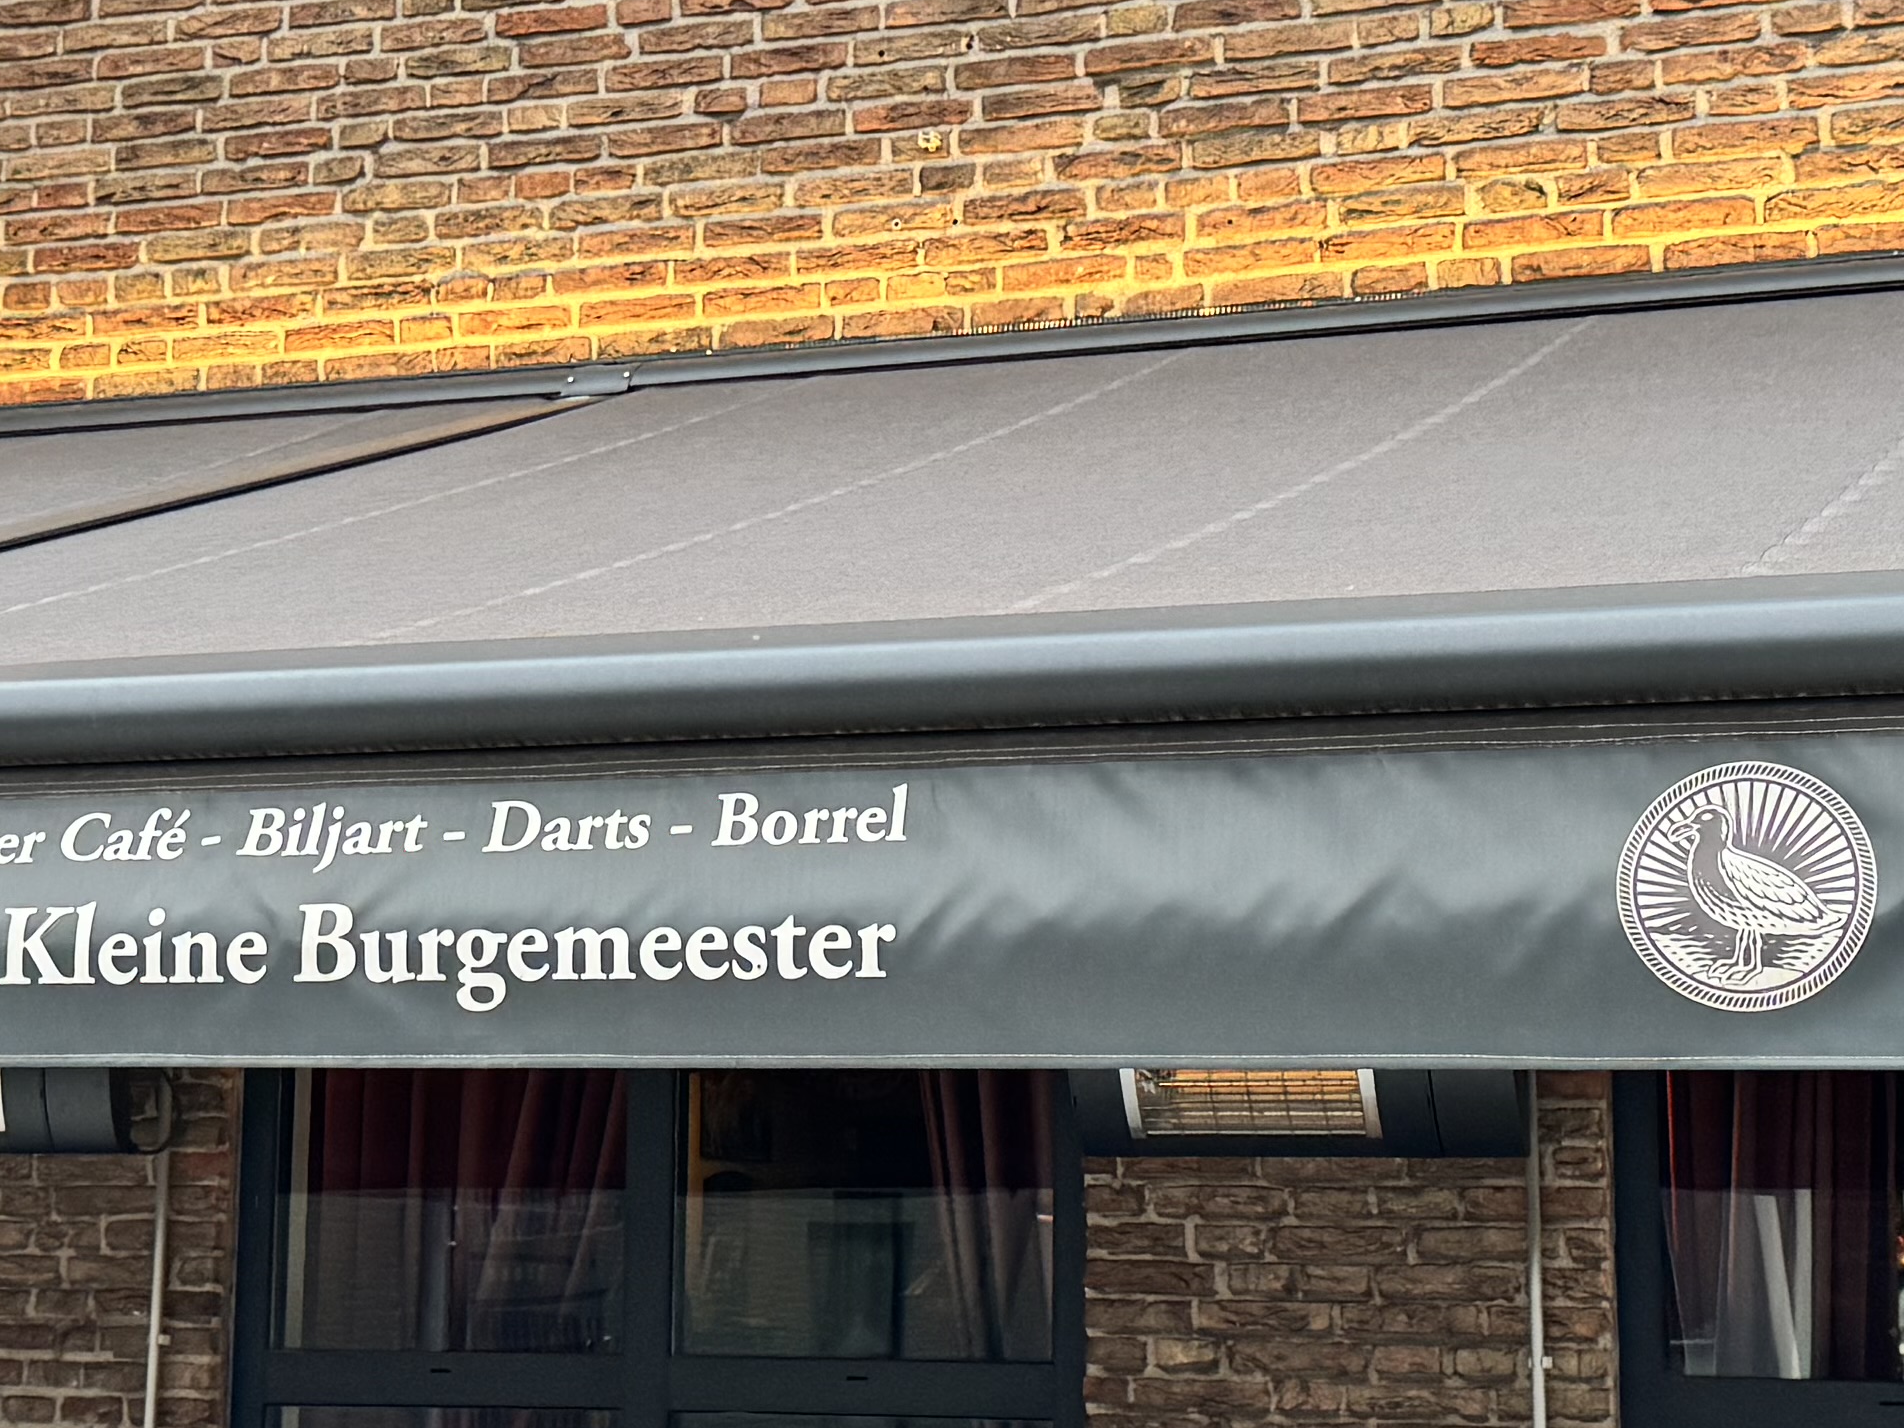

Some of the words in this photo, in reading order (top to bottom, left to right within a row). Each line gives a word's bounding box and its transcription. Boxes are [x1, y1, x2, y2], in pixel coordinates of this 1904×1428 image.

[60, 807, 191, 862] Café
[235, 802, 428, 874] Biljart
[481, 800, 651, 853] Darts
[710, 783, 908, 847] Borrel
[293, 903, 896, 1012] Burgemeester
